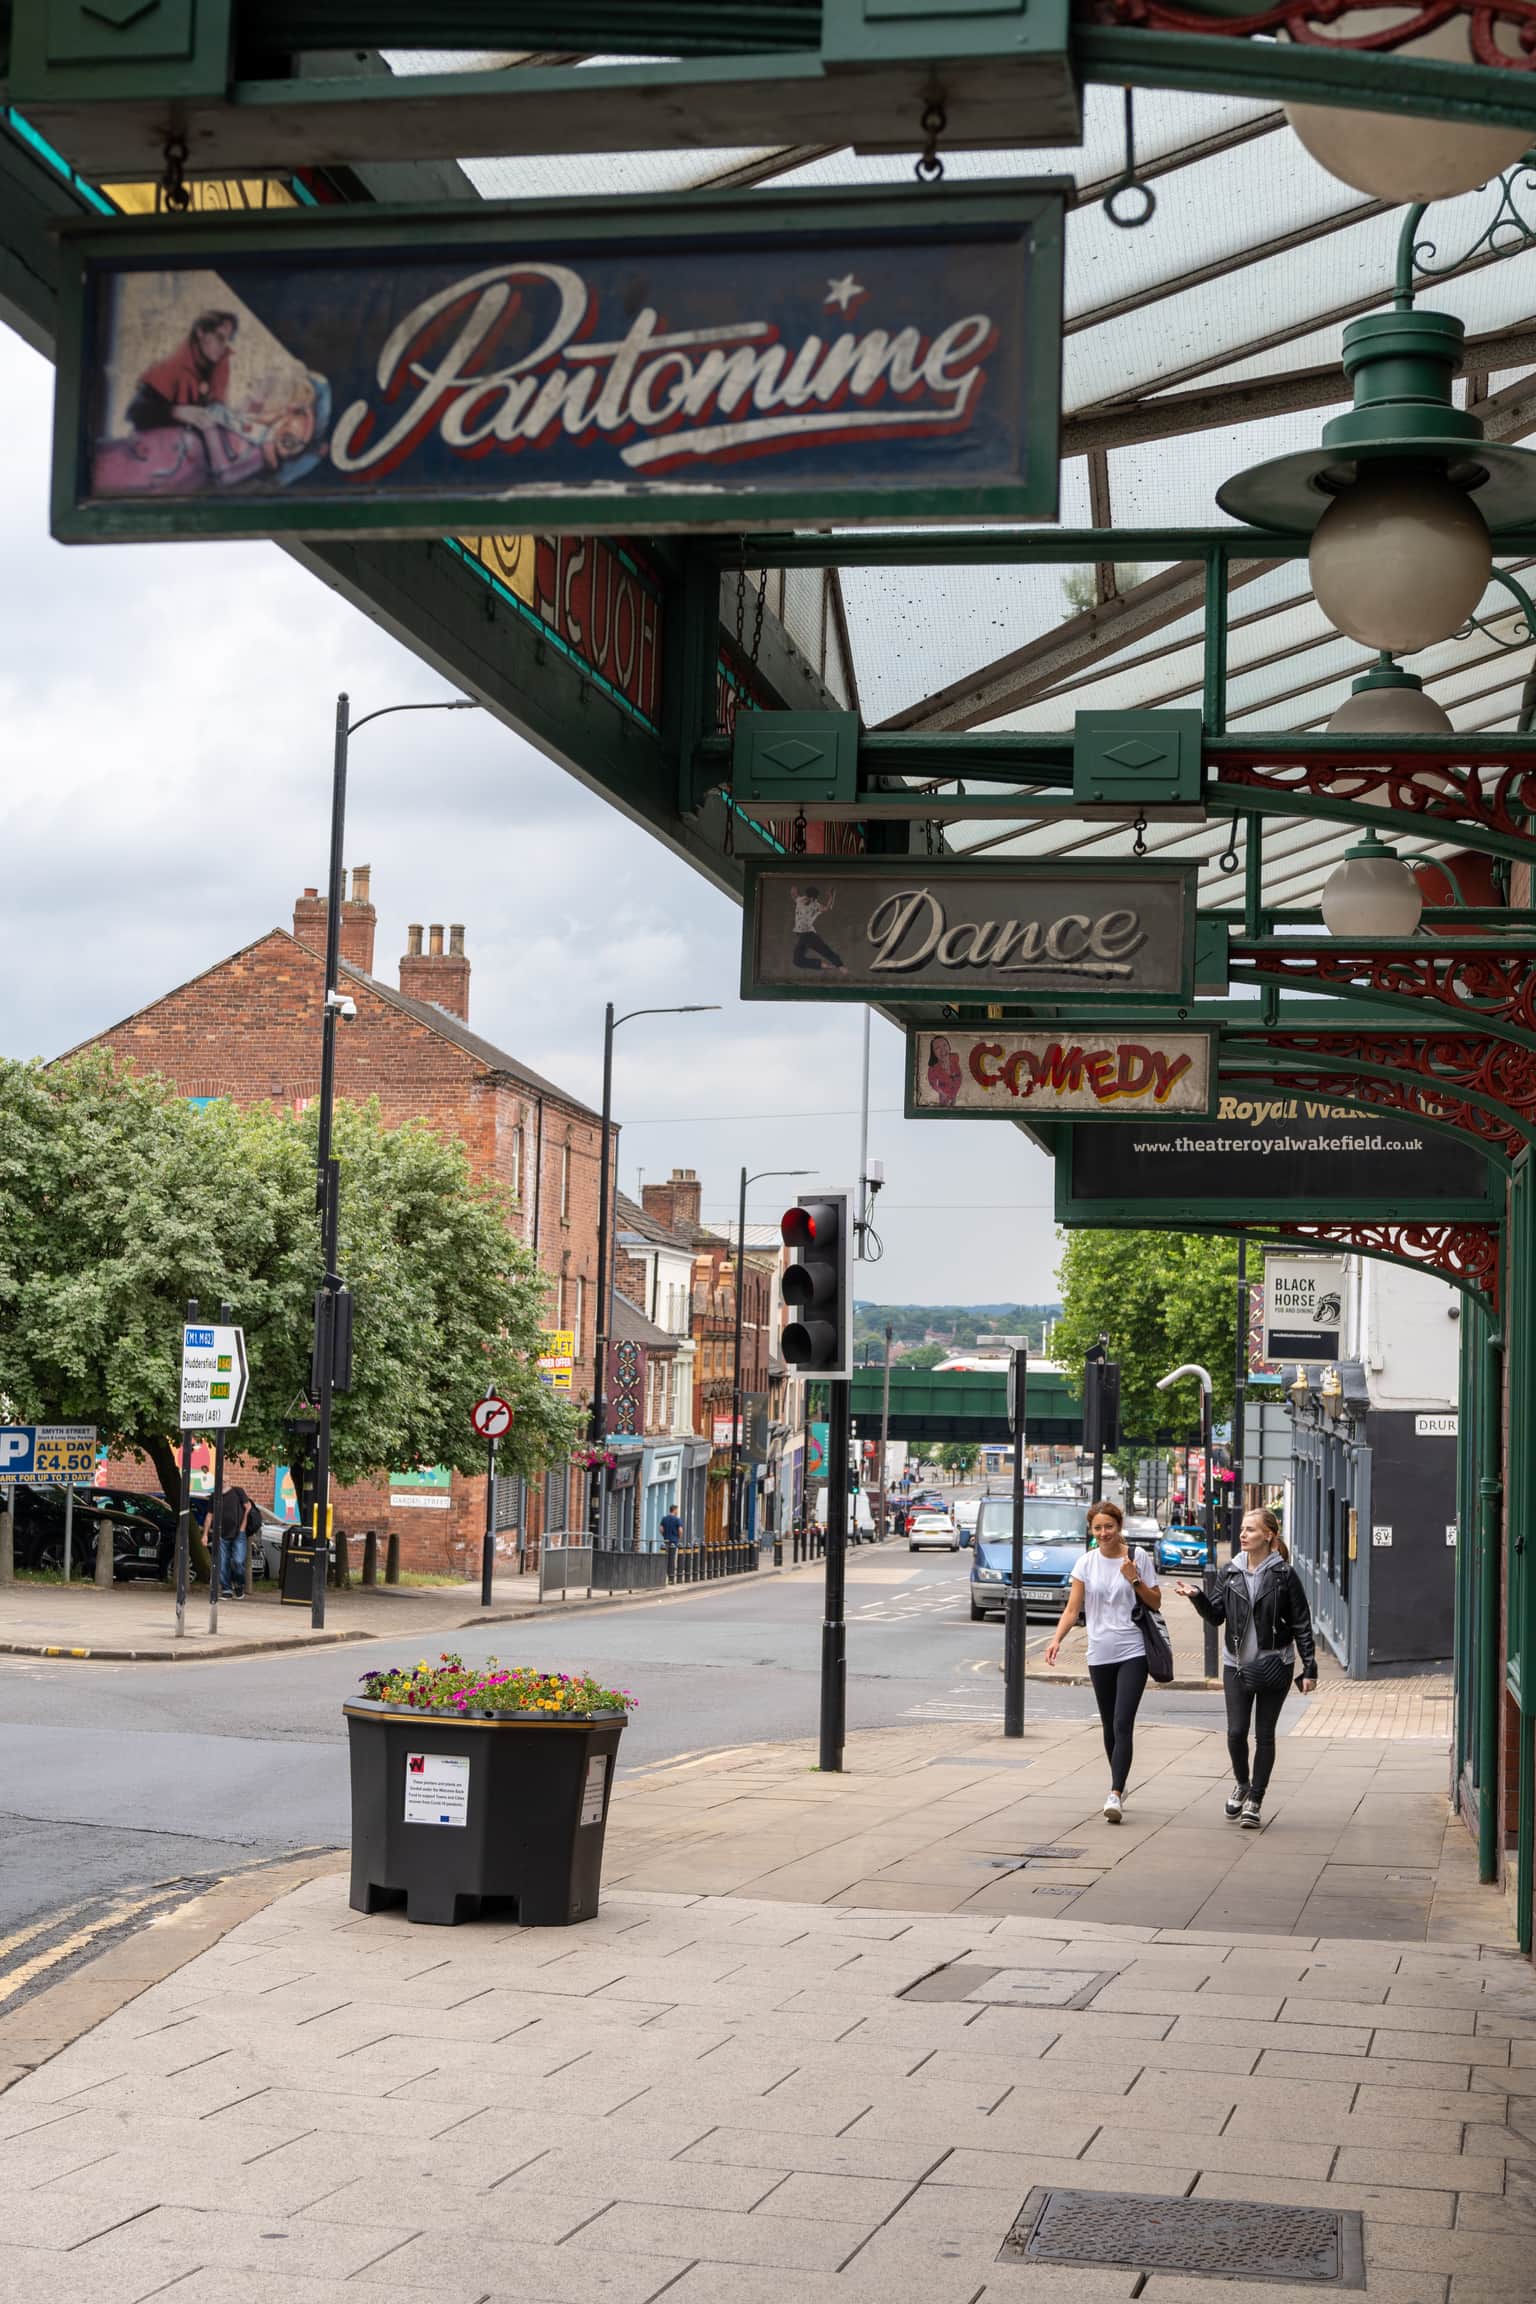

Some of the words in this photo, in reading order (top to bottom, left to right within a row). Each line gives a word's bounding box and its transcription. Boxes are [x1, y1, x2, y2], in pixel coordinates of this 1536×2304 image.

[331, 262, 996, 476] Pantomime
[867, 888, 1146, 973] Dance
[969, 1042, 1192, 1102] COMEDY
[1217, 1096, 1298, 1126] Royal
[1133, 1136, 1424, 1155] www.theatreroyalwakefield.co.uk
[1275, 1278, 1316, 1292] BLACK
[1274, 1294, 1316, 1307] HORSE
[184, 1357, 217, 1369] Huddersfield
[183, 1377, 209, 1391] Dewsbury
[183, 1391, 209, 1404] Doncaster
[182, 1410, 204, 1424] Barnsley
[0, 1433, 29, 1467] P
[38, 1443, 62, 1451] ALL
[66, 1443, 92, 1451] DAY
[36, 1455, 92, 1471] £4.50
[19, 1474, 35, 1482] FOR
[38, 1474, 49, 1482] UP
